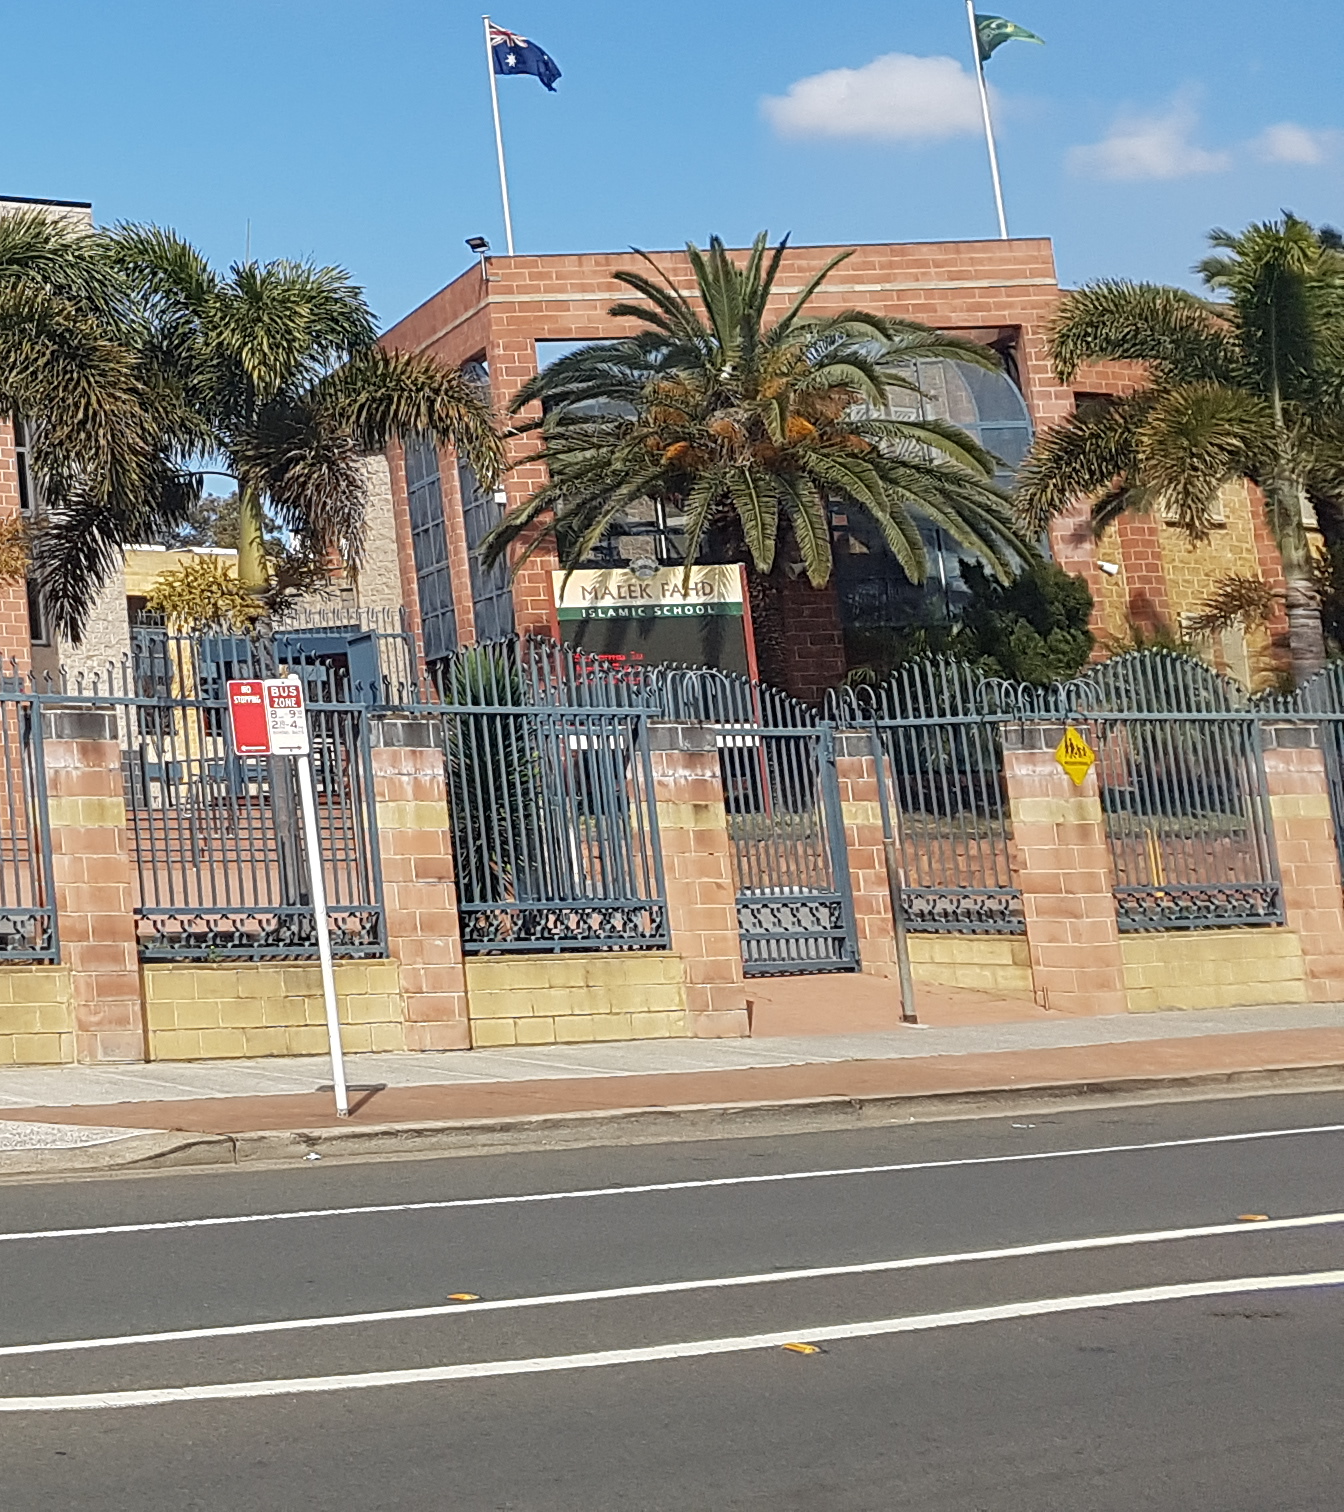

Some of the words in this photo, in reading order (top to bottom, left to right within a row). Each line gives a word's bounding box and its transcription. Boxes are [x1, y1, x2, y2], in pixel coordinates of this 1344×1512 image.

[580, 583, 653, 601] MALEK
[661, 581, 714, 598] FAHD
[581, 607, 646, 618] ISLAMIC
[654, 605, 715, 617] SCHOOL
[240, 685, 252, 694] NO
[270, 686, 297, 697] BUS
[233, 695, 262, 704] STOPPING
[272, 697, 298, 708] ZONE
